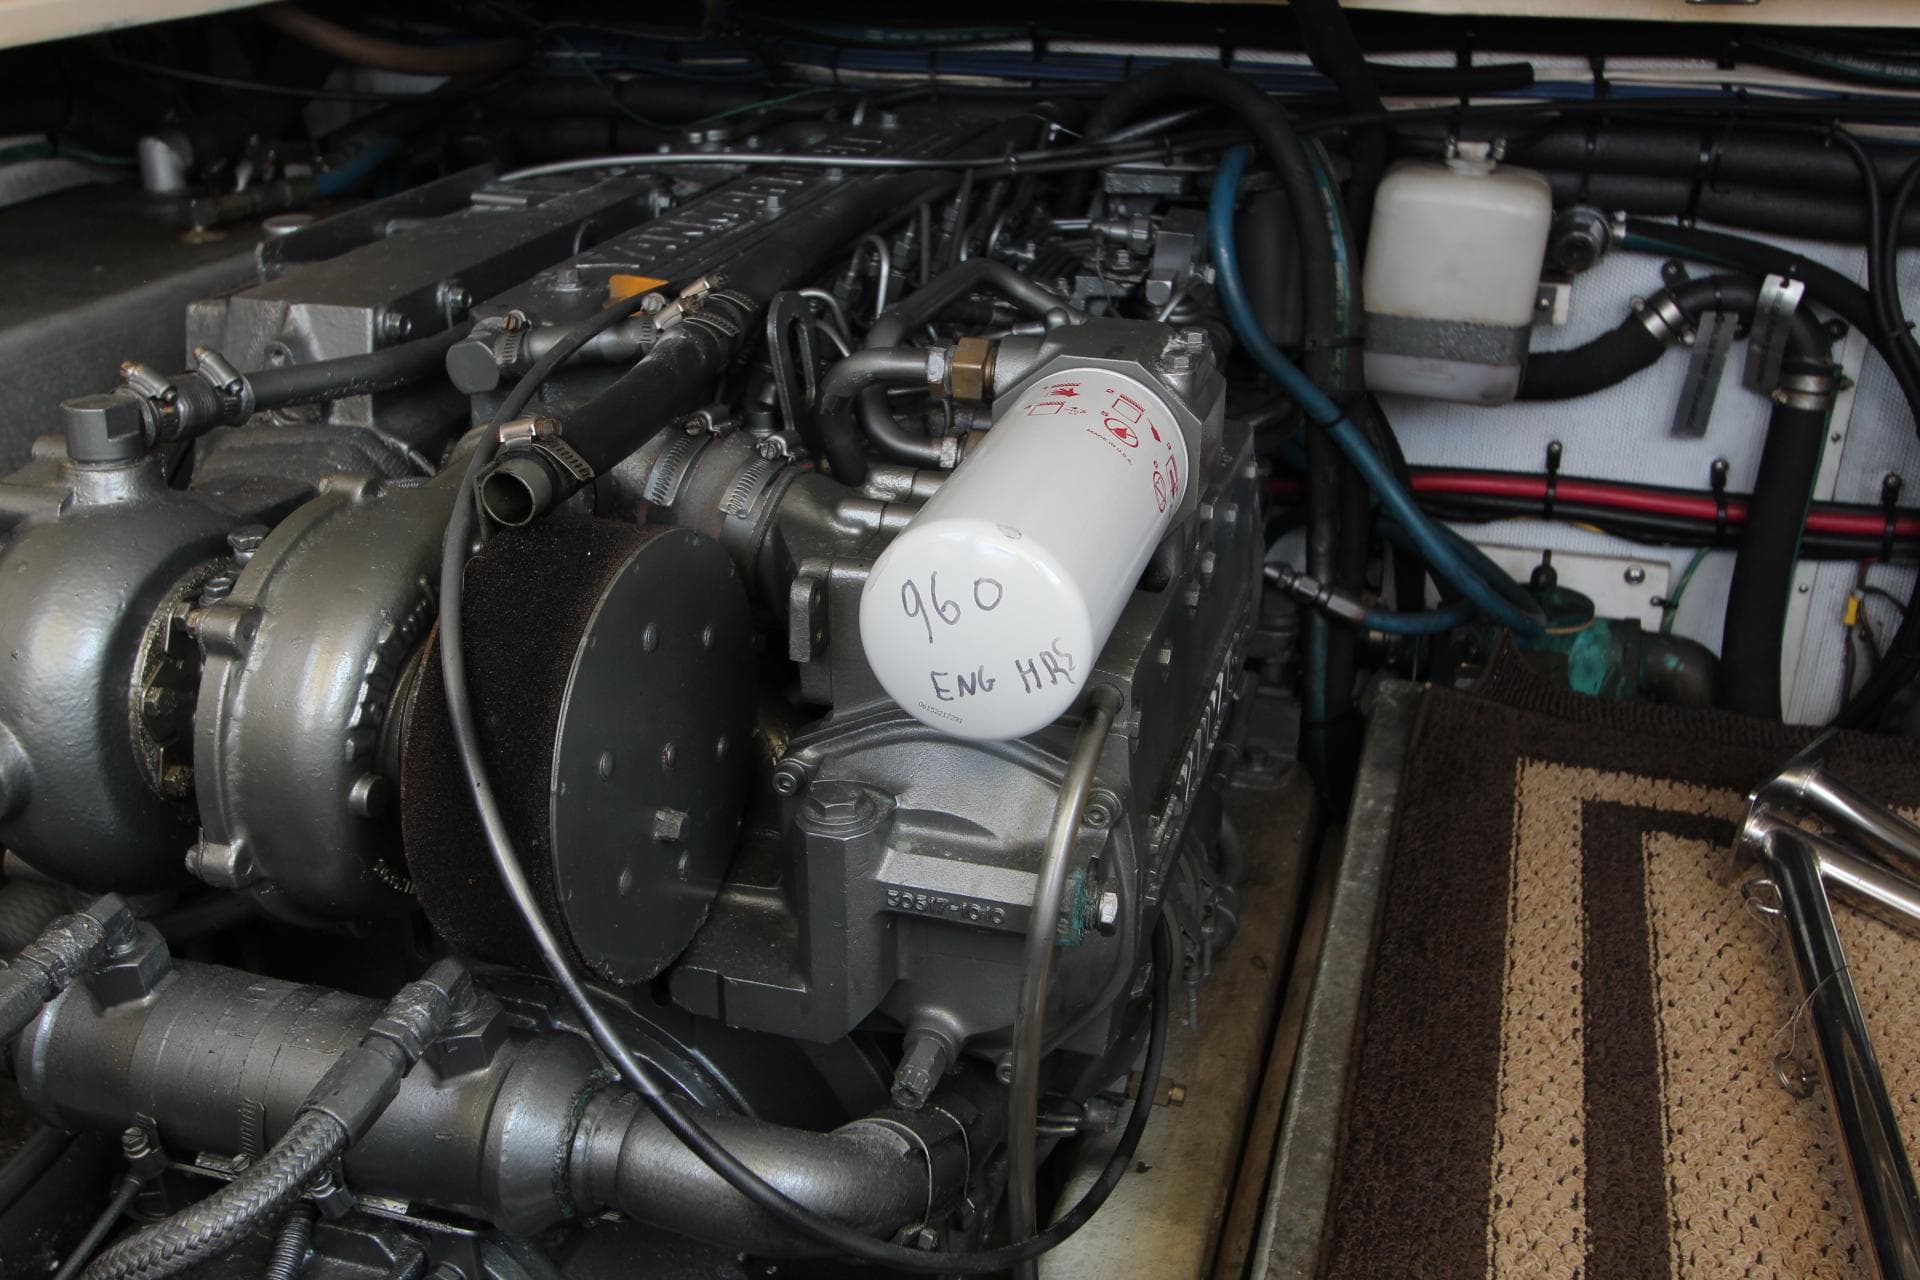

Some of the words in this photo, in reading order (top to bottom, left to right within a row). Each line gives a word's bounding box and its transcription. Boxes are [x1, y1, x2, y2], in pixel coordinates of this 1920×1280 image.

[901, 571, 1003, 643] 960
[930, 664, 996, 701] ENG
[1015, 637, 1077, 694] HRS
